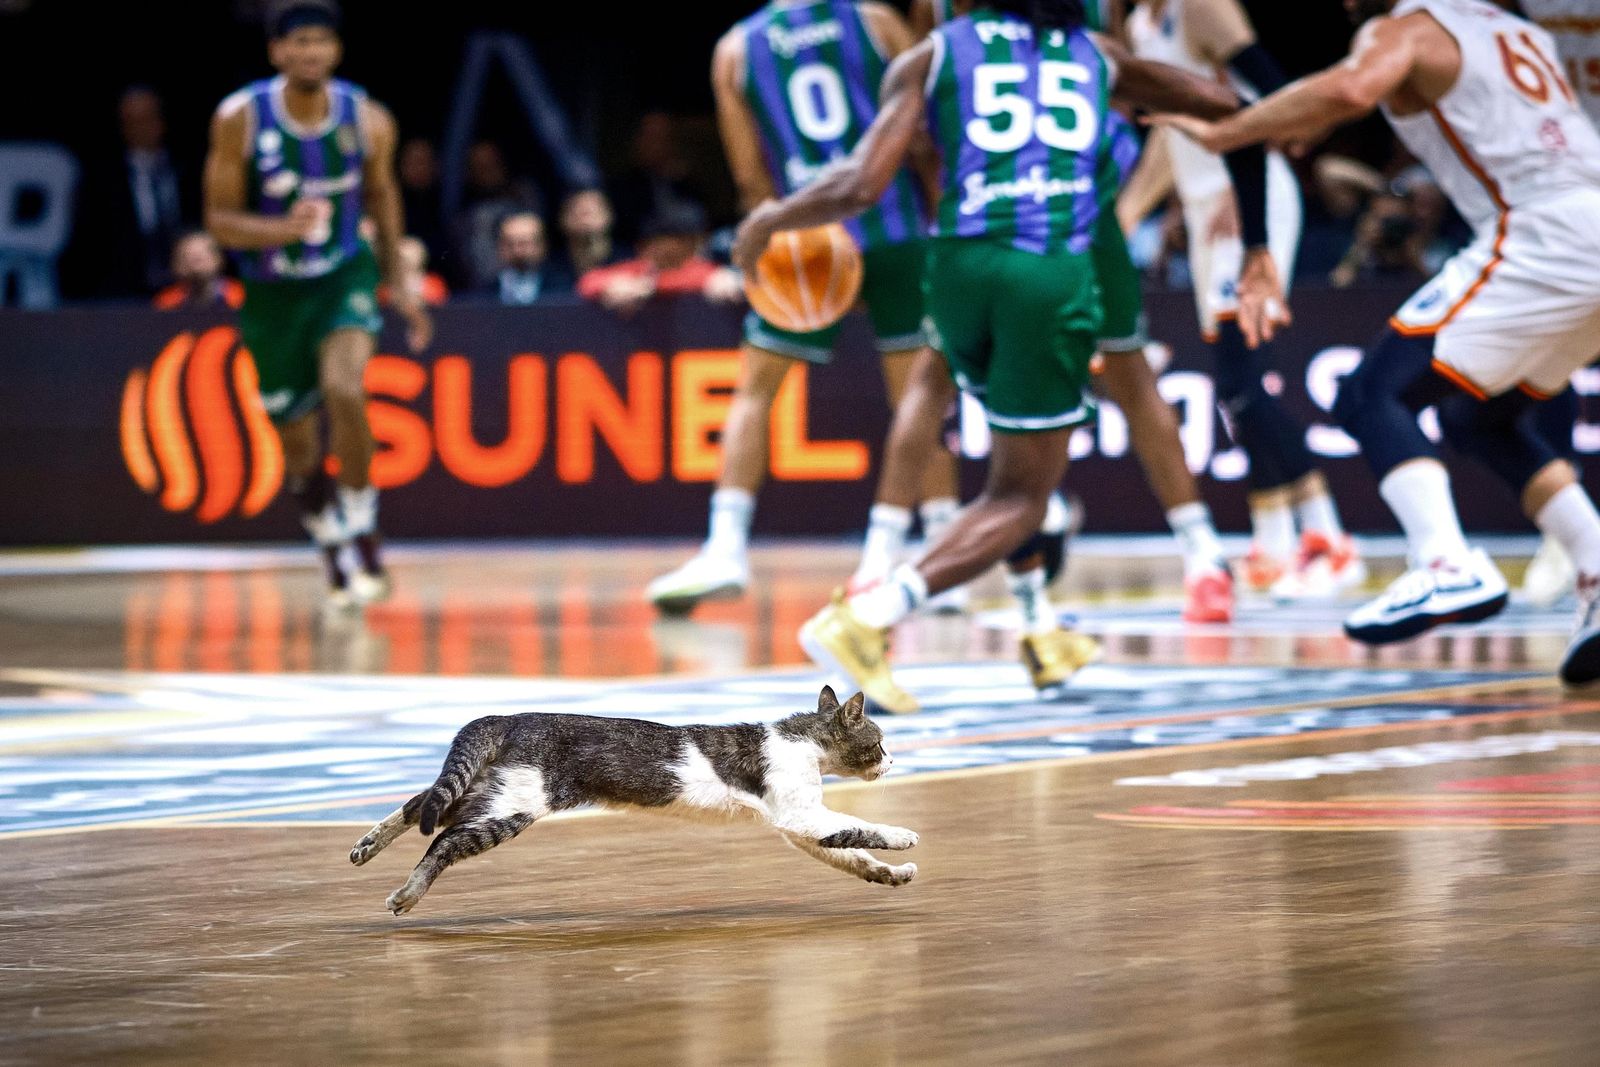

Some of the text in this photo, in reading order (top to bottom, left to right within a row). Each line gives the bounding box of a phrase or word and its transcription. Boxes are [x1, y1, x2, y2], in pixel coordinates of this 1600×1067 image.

[787, 63, 851, 142] 0
[966, 60, 1100, 152] 55
[1494, 31, 1577, 108] 61
[330, 350, 869, 489] SUNEL
